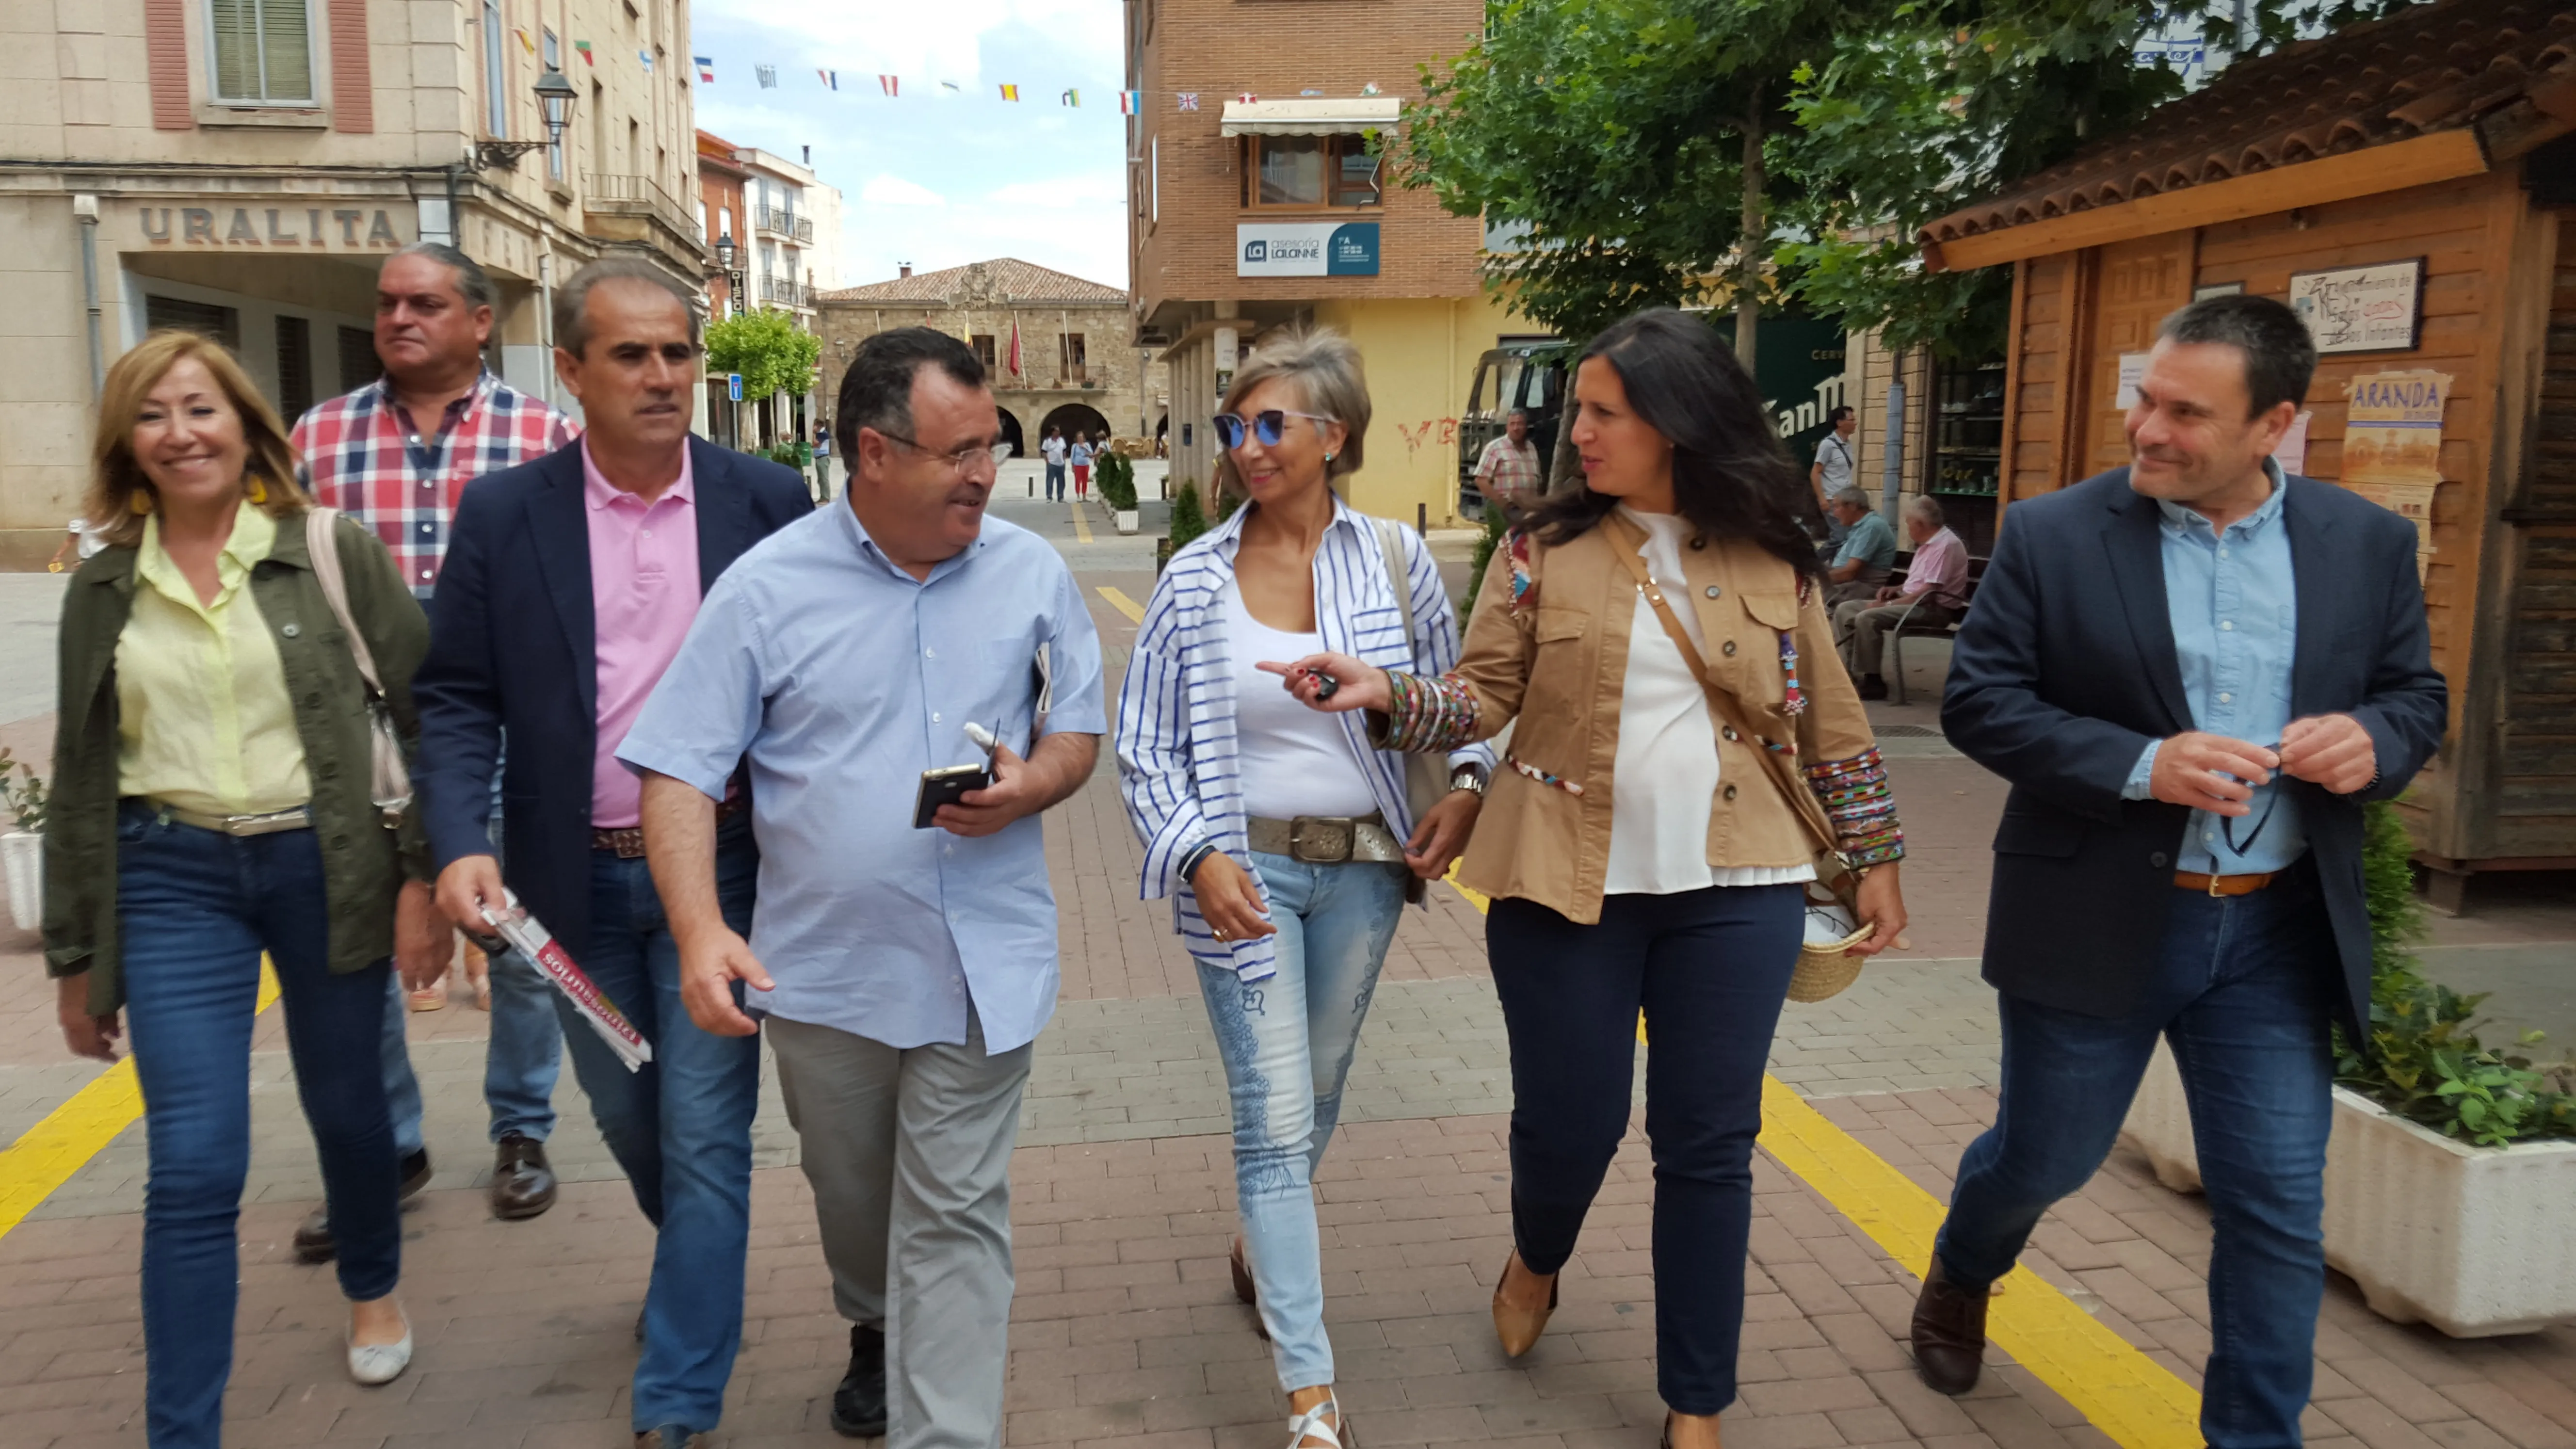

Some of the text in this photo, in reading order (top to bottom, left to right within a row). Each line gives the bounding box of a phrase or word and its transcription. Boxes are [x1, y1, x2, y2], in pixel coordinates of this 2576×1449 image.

[140, 207, 400, 246] URALITA
[1271, 237, 1319, 248] asesoría
[2352, 382, 2439, 408] ARANDA
